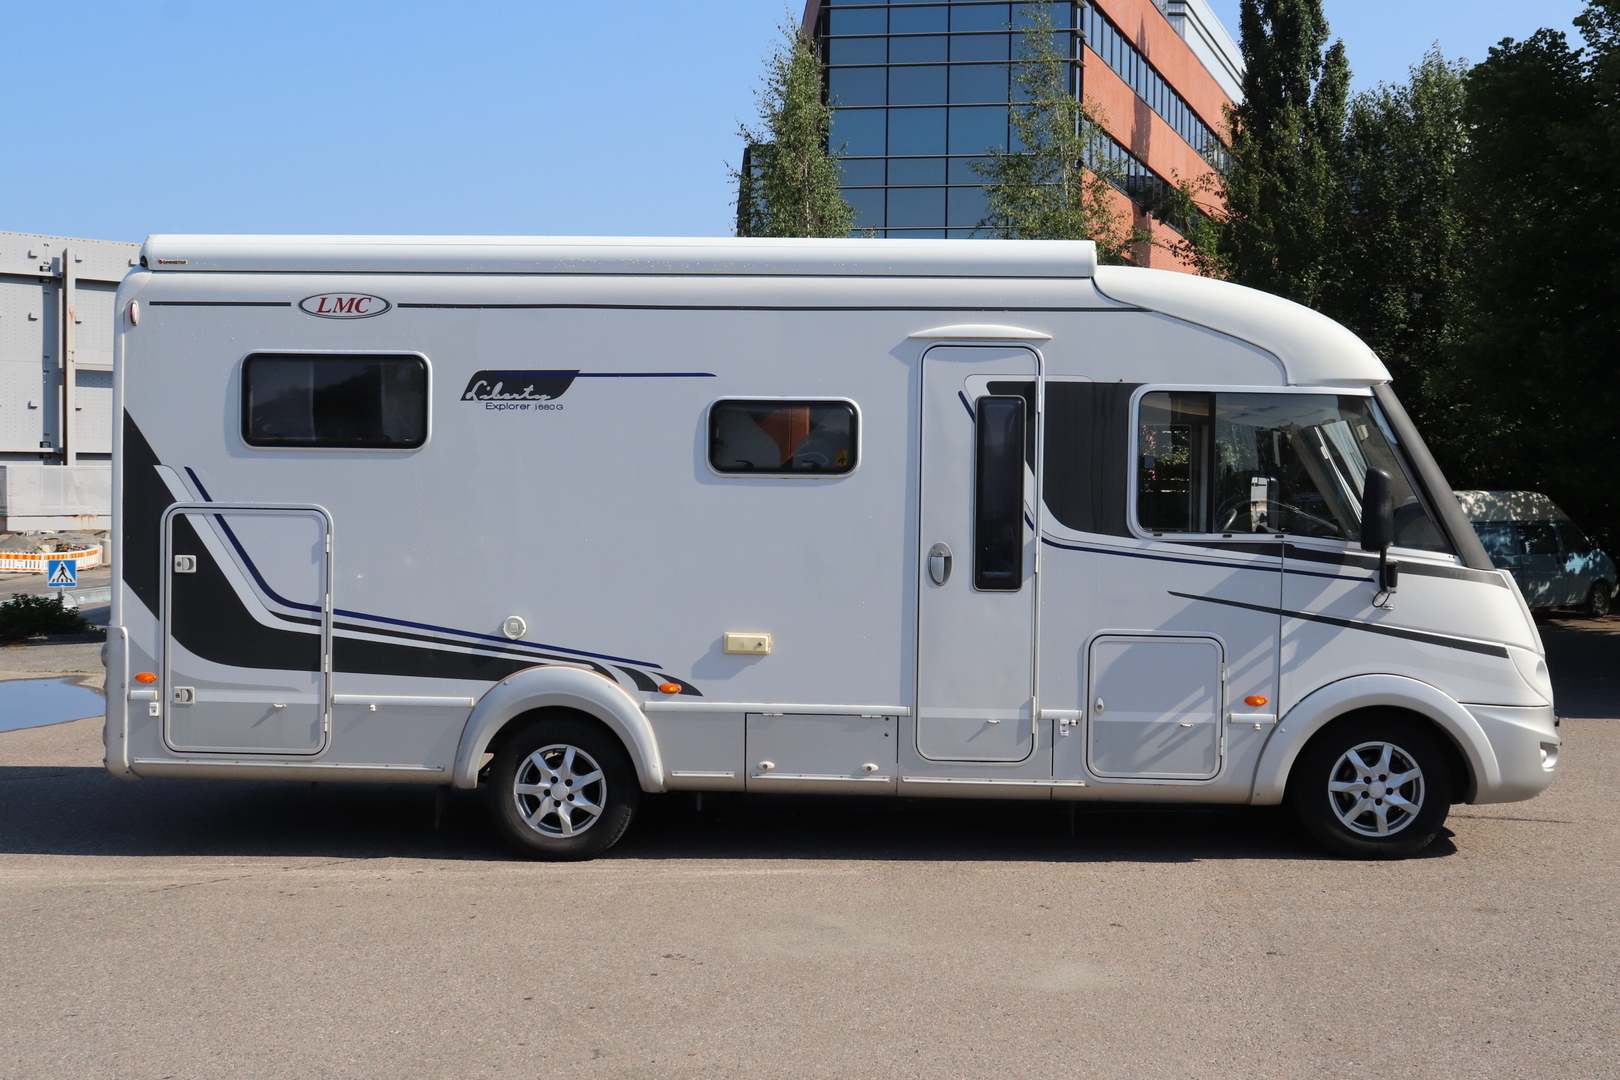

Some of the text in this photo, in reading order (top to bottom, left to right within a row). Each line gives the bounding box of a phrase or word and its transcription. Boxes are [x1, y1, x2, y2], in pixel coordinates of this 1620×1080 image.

[316, 297, 372, 314] LMC
[465, 380, 551, 404] Liberty
[485, 401, 531, 411] Explorer
